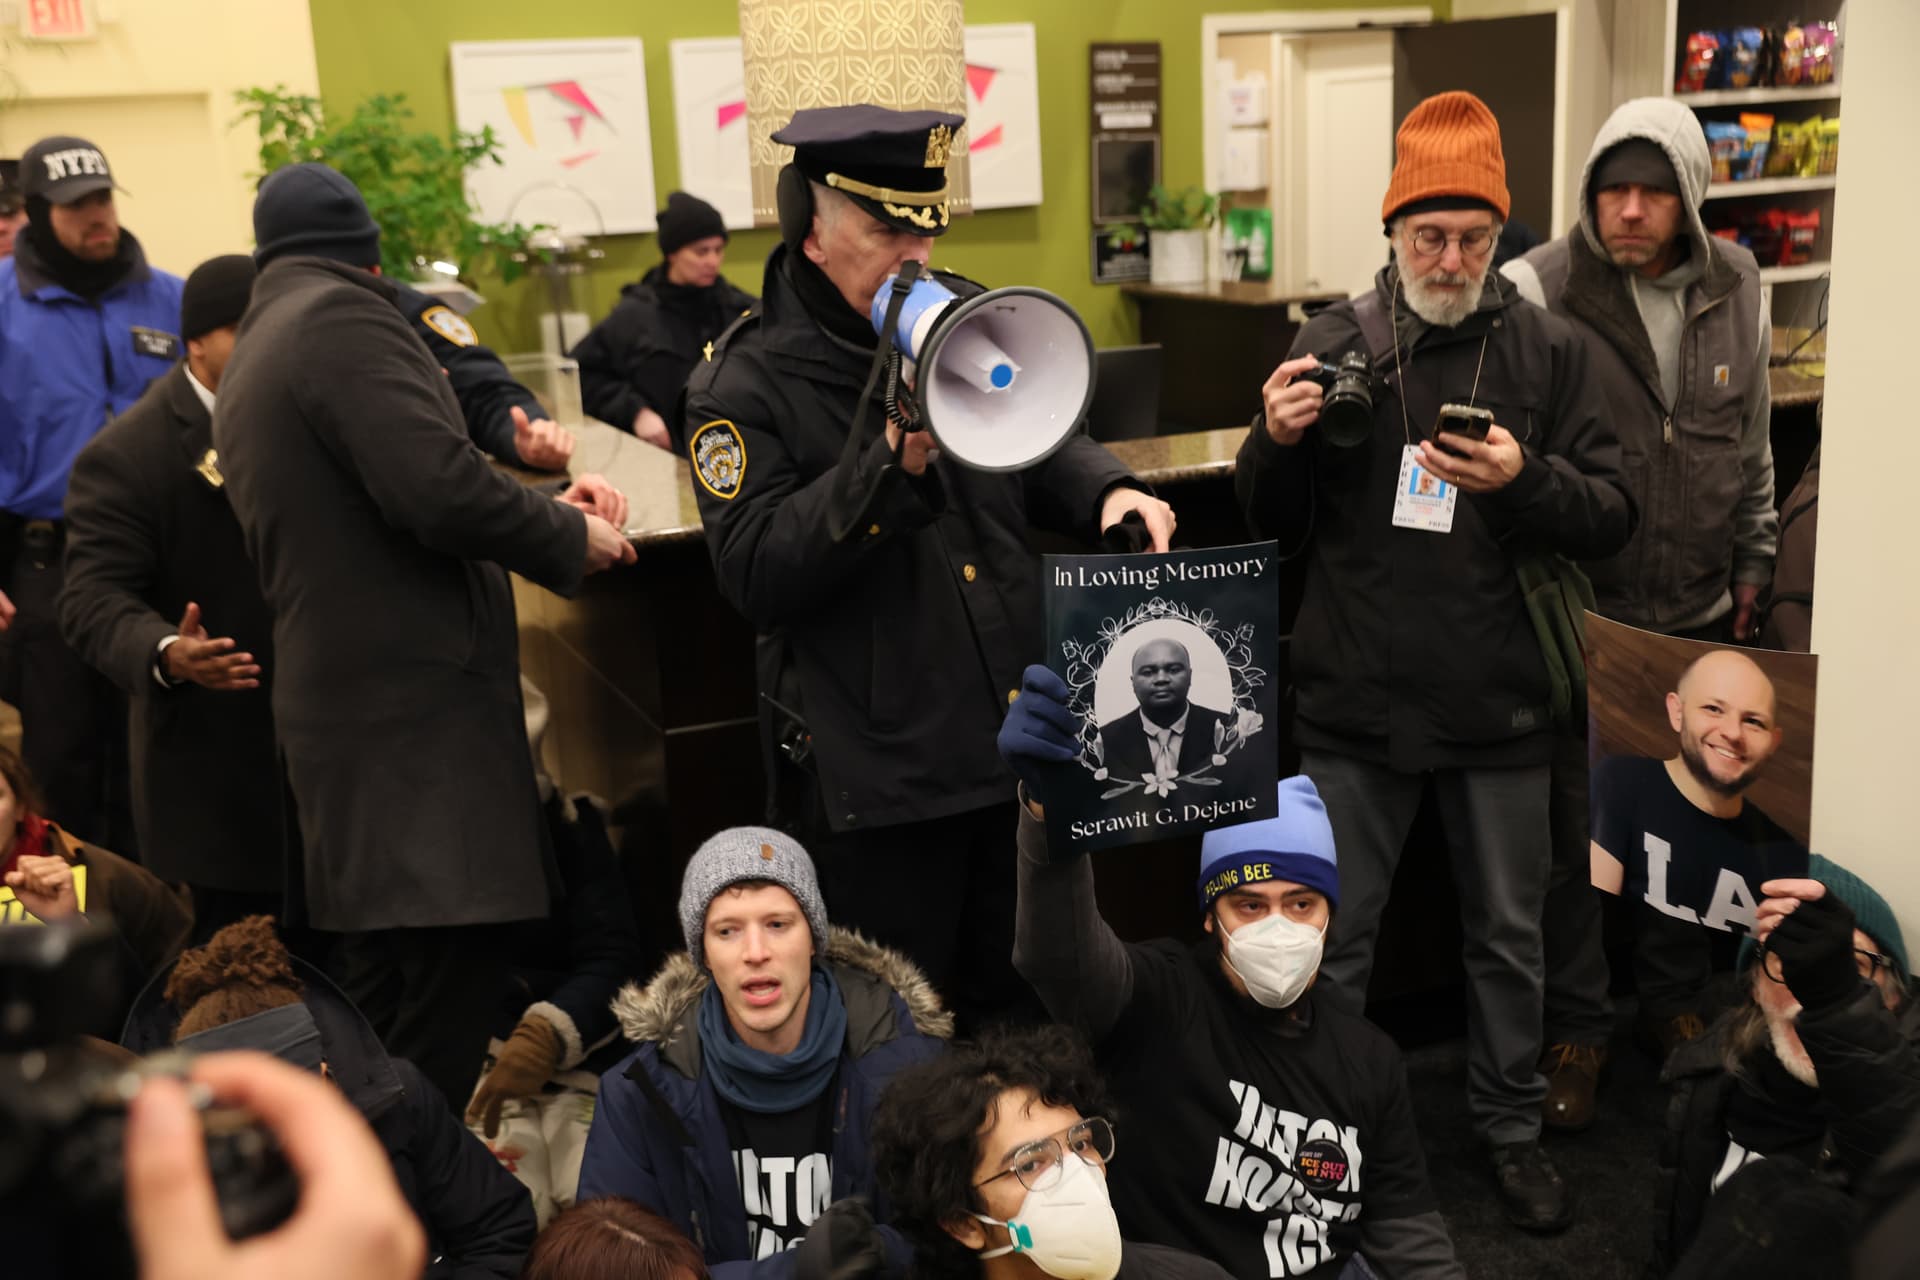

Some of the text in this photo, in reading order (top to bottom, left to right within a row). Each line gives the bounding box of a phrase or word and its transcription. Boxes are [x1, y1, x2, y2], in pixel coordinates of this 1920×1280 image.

[42, 148, 109, 181] NYPD
[1055, 557, 1268, 590] In Loving Memory
[1071, 796, 1257, 840] Serawit G. Dejene
[1243, 863, 1273, 882] BEE
[1643, 831, 1760, 938] LA
[1300, 1157, 1345, 1172] ICE OUT
[1320, 1168, 1344, 1181] NYC
